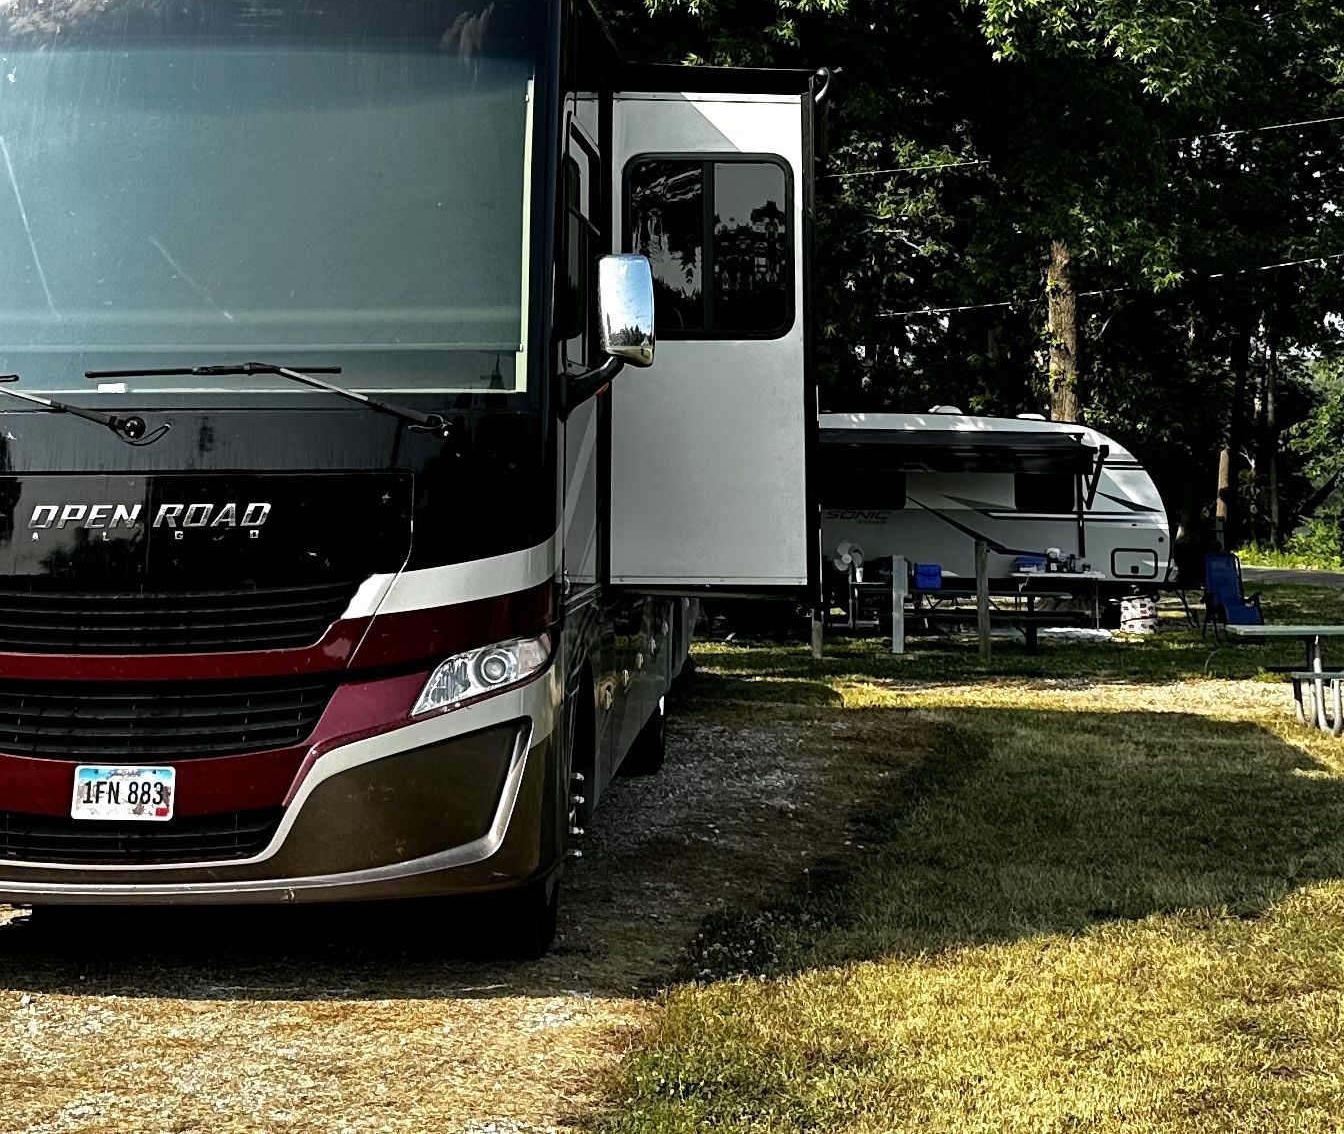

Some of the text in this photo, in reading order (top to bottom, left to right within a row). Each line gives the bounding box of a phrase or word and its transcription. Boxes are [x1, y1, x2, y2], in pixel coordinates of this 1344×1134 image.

[27, 502, 272, 529] OPEN ROAD
[824, 510, 893, 520] SONIC
[82, 780, 164, 805] 1FN 883
